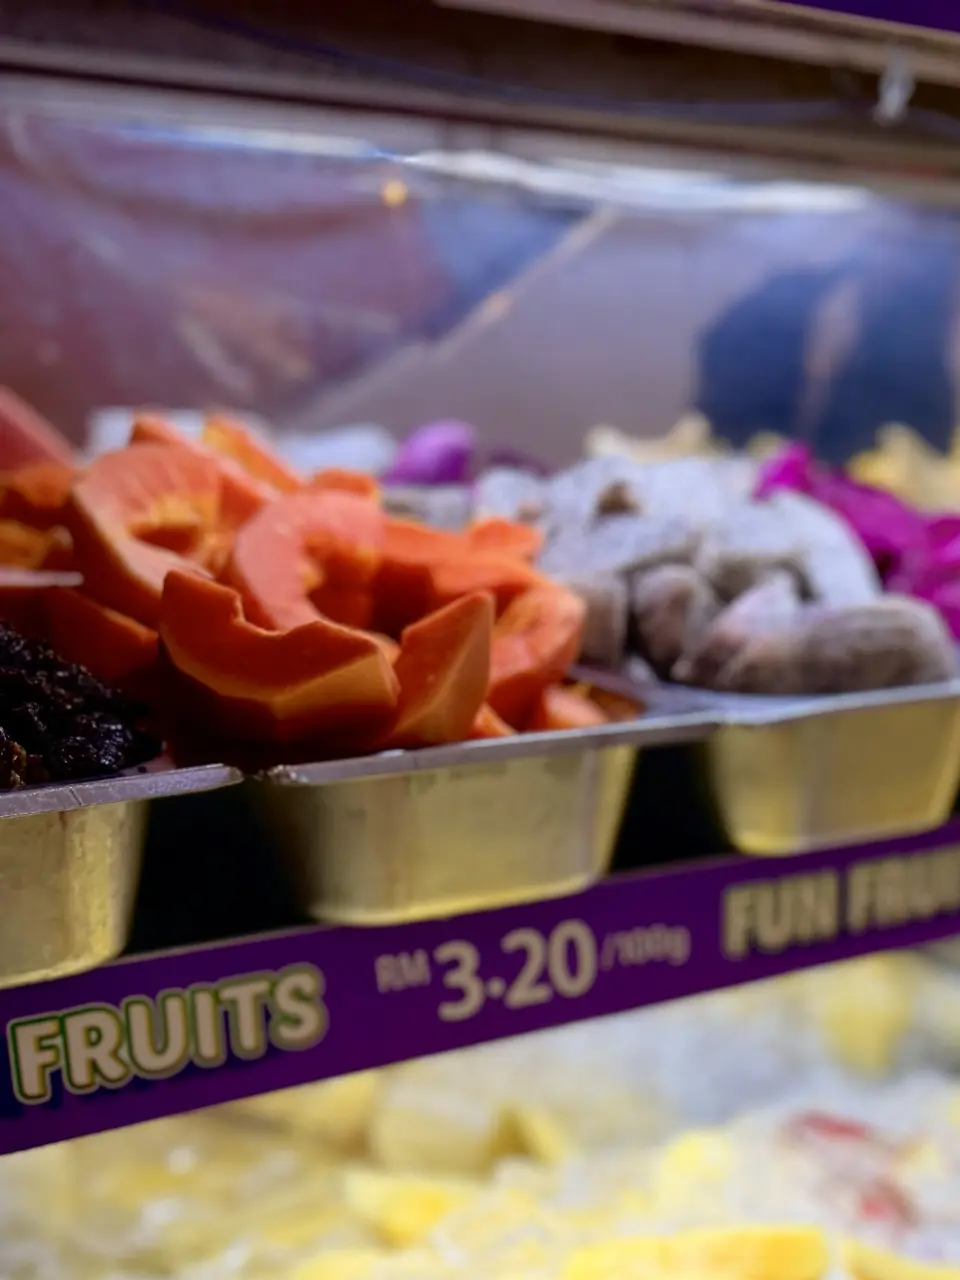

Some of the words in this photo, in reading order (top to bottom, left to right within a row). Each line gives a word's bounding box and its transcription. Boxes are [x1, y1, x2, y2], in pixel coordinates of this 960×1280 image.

[721, 867, 839, 960] FUN
[375, 948, 431, 994] RM
[434, 919, 599, 1022] 3.20
[7, 962, 330, 1105] FRUITS
